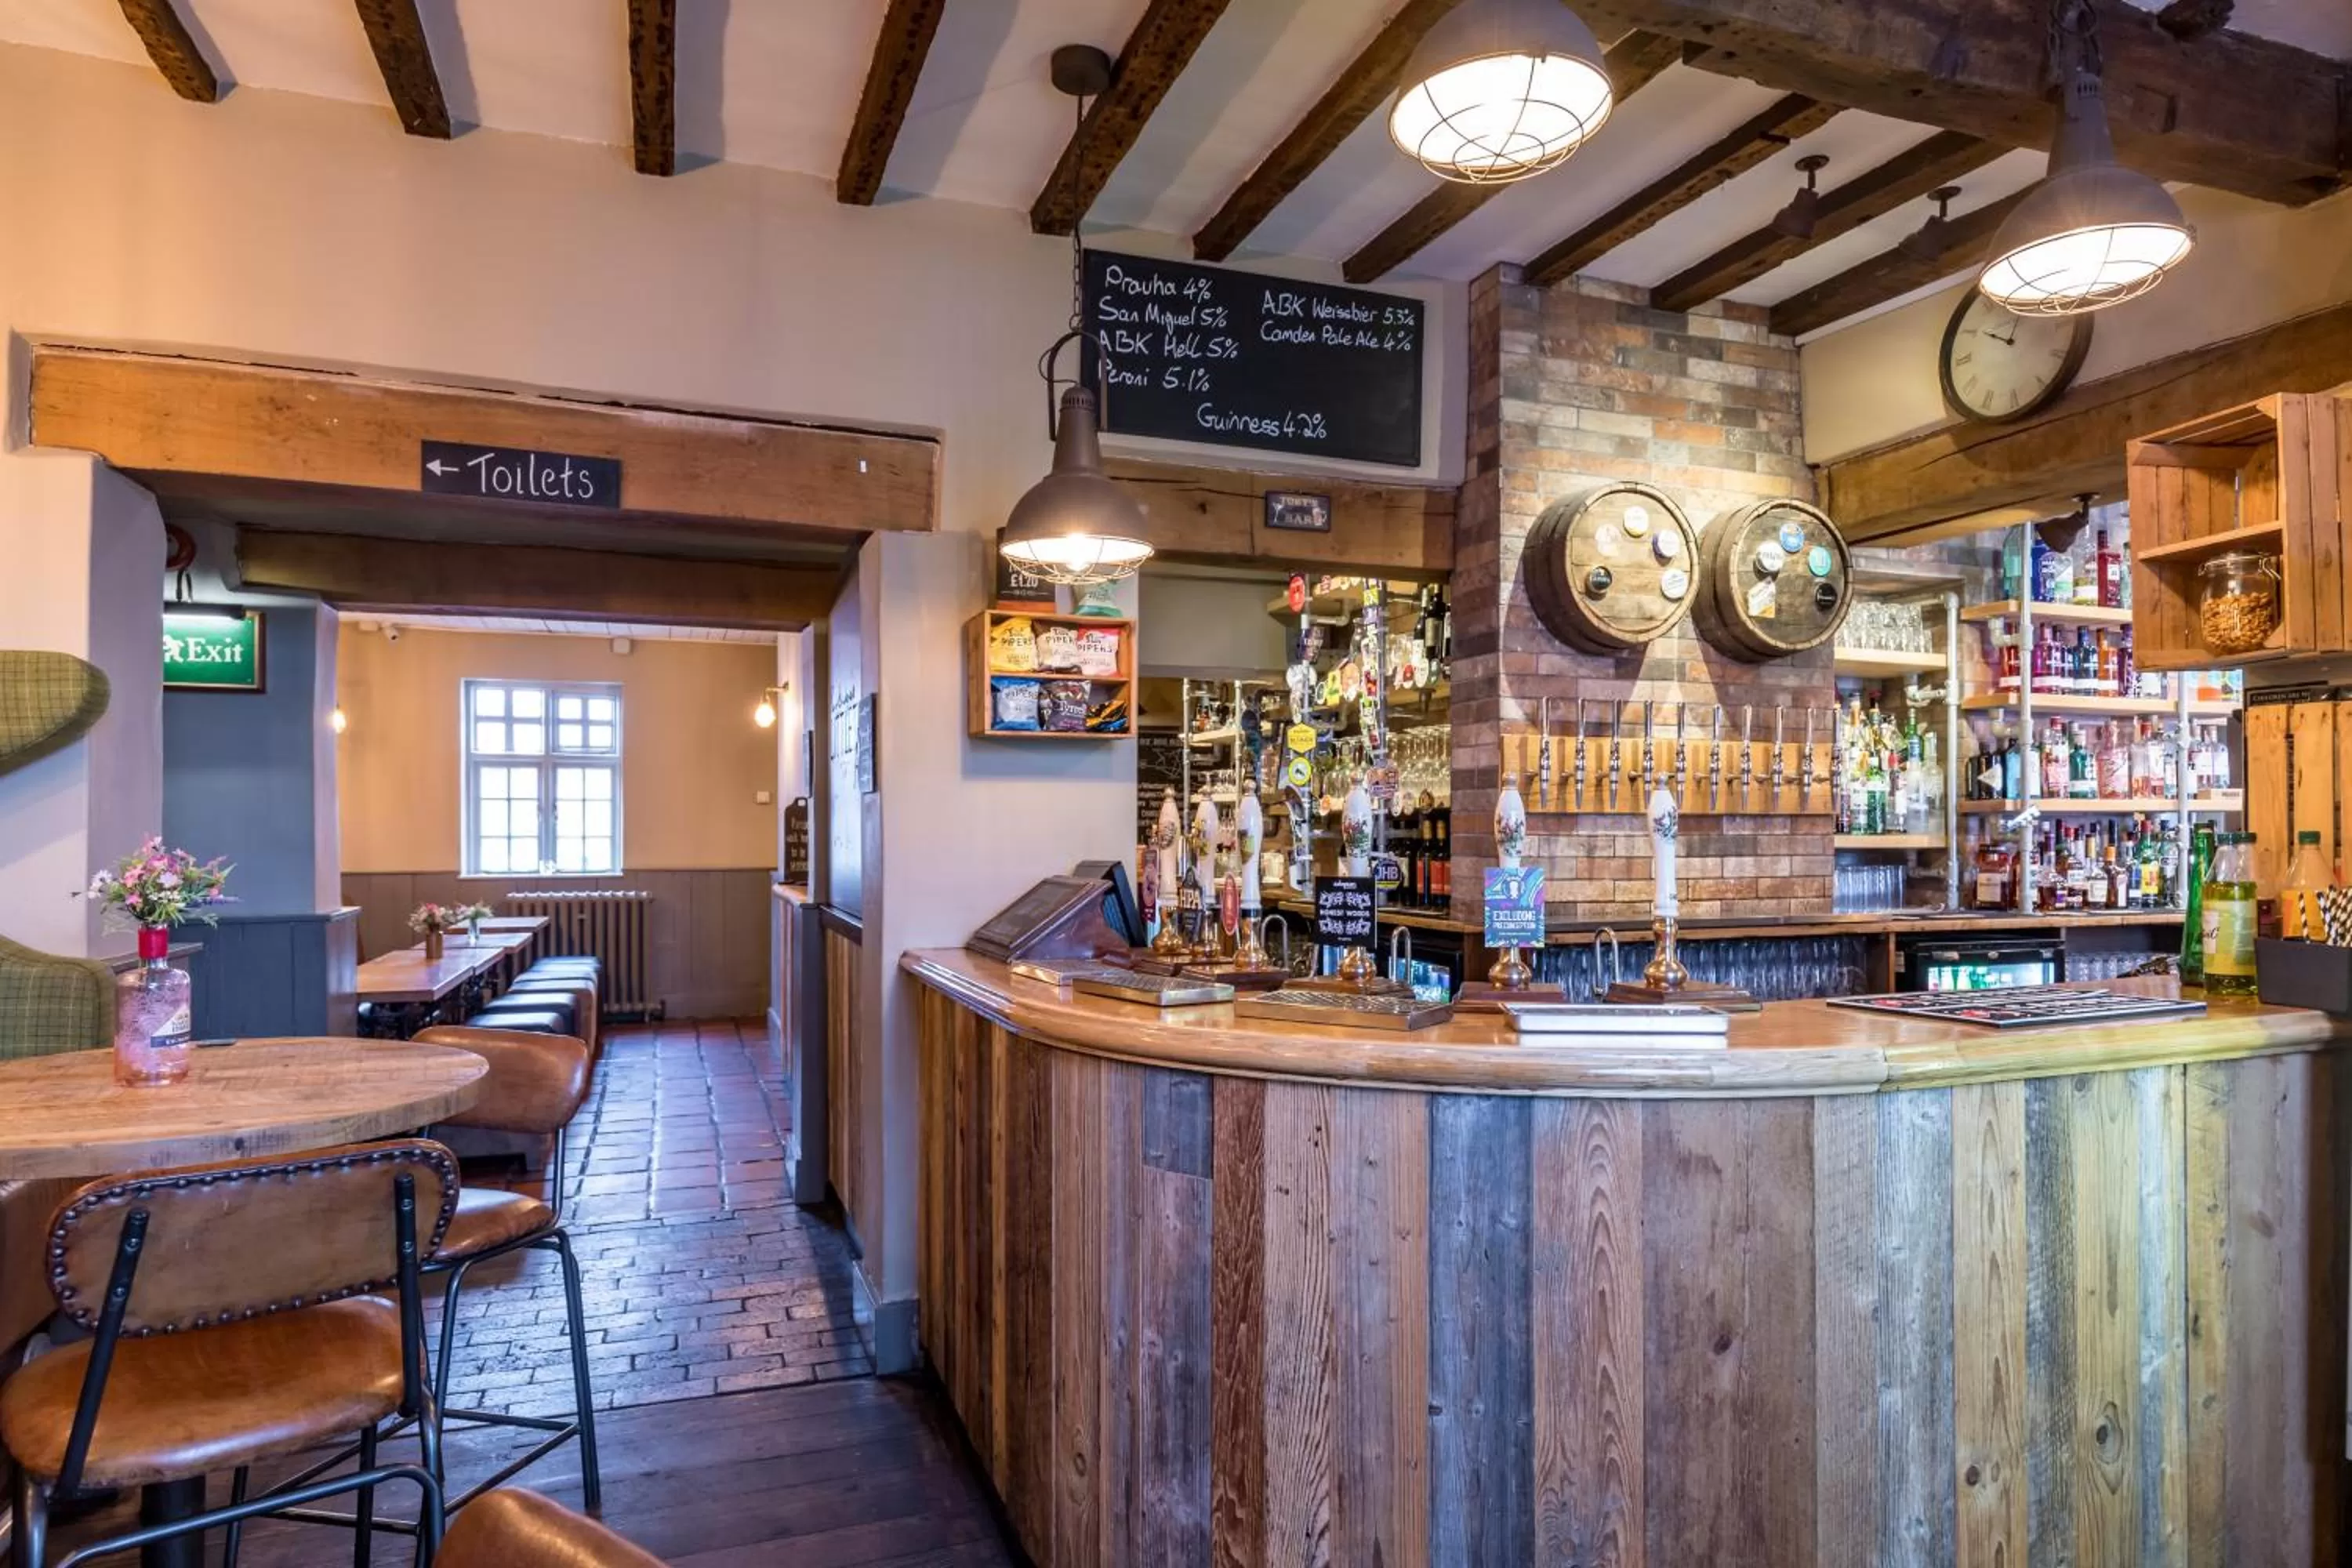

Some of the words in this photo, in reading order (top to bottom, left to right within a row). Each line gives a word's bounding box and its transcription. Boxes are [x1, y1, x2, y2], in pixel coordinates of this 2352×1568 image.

[1183, 277, 1213, 303] 4%
[1098, 295, 1138, 321] San
[1145, 302, 1197, 336] Miguel
[1200, 307, 1229, 328] 5%
[1261, 289, 1306, 318] ABK
[1312, 296, 1378, 323] Weissbier
[1382, 307, 1416, 326] 5.3%
[1099, 328, 1153, 354] ABK
[1164, 332, 1202, 358] Hell
[1206, 337, 1238, 358] 5%
[1260, 320, 1316, 343] Camden
[1322, 324, 1353, 346] Pale
[1355, 329, 1380, 349] Ale
[1383, 330, 1414, 351] 4%
[1098, 358, 1150, 387] Peroni
[1163, 366, 1210, 392] 5.1%
[1197, 402, 1280, 437] Guinness
[1283, 410, 1327, 439] 4.2%
[466, 452, 593, 499] Toilets
[185, 637, 244, 663] Exit
[1375, 866, 1399, 880] JHB
